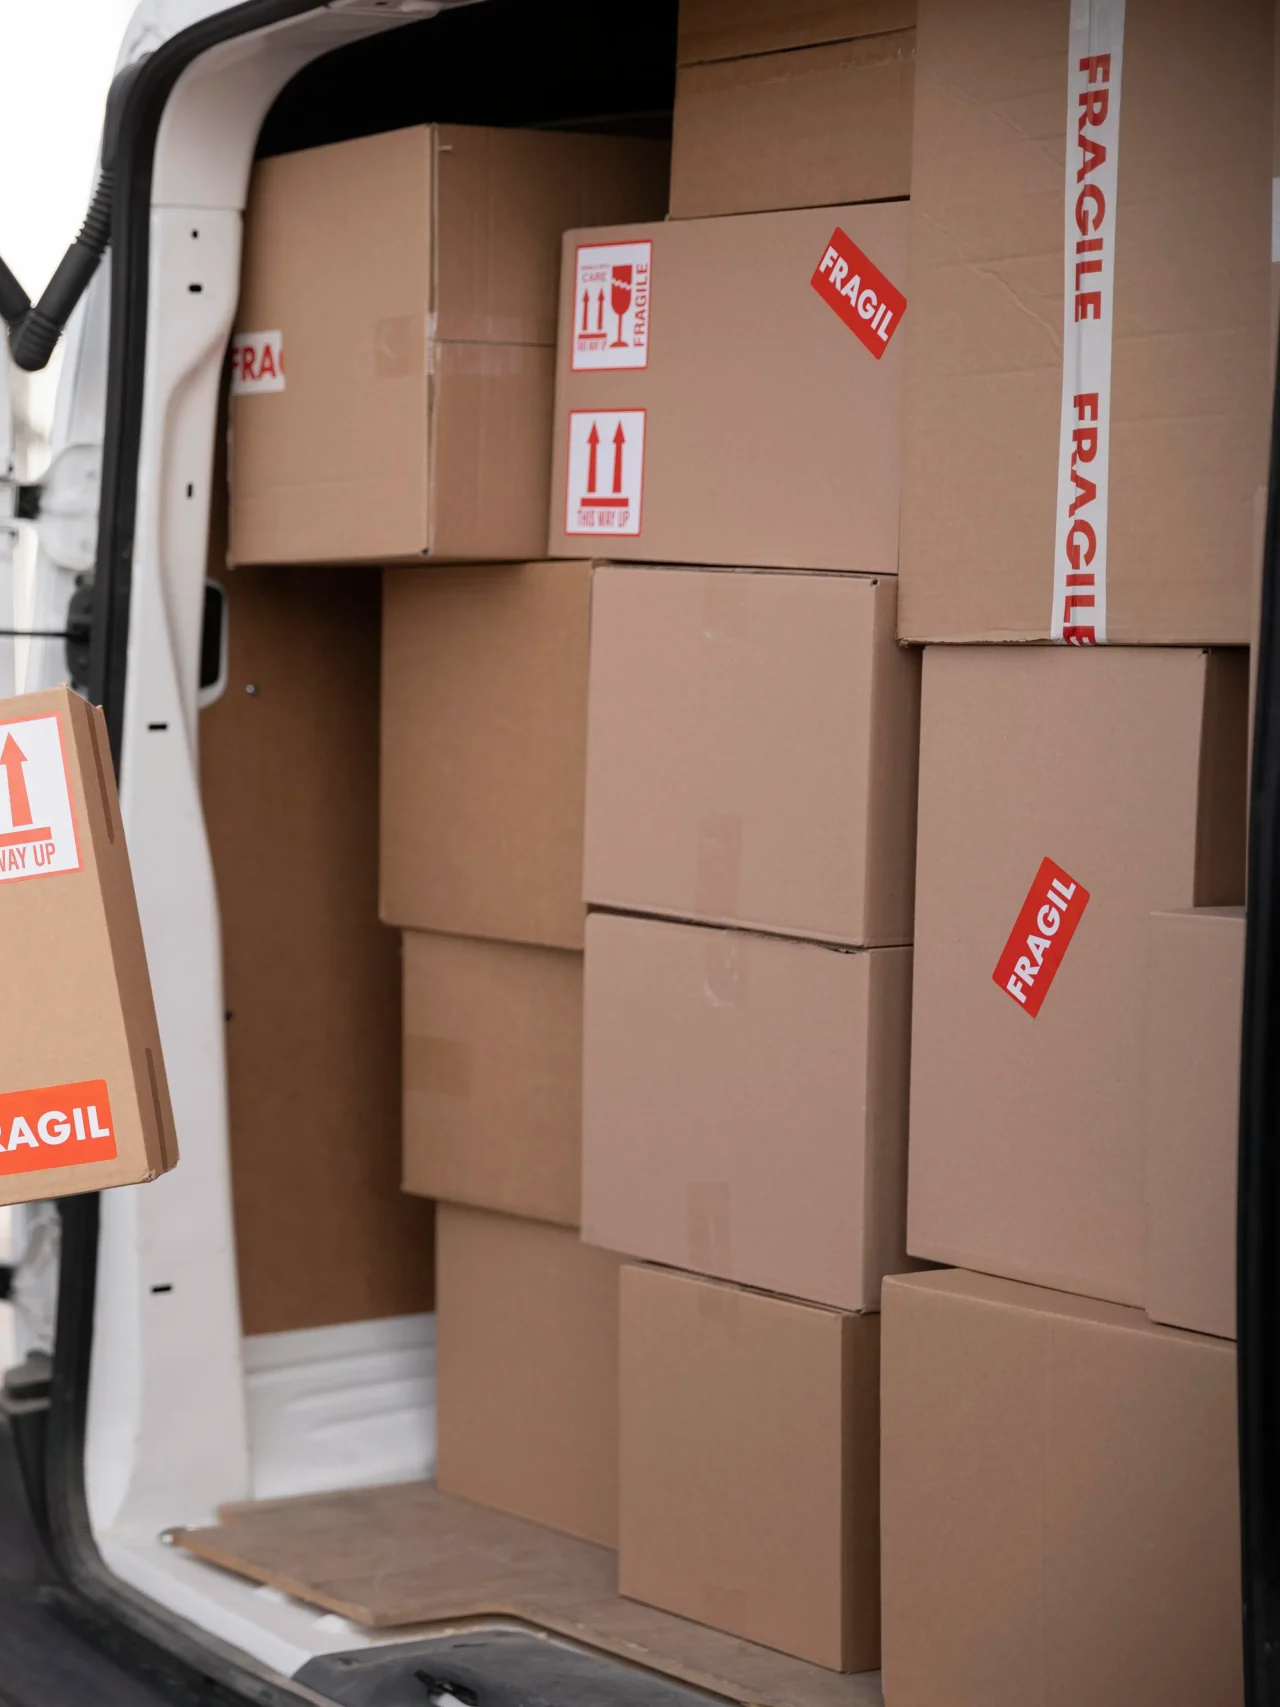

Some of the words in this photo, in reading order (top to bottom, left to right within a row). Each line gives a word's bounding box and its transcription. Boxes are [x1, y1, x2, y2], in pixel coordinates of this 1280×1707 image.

[1074, 53, 1111, 323] FRAGILE
[633, 264, 648, 347] FRAGILE
[819, 245, 893, 342] FRAGIL
[231, 345, 285, 381] FRA
[577, 509, 595, 528] THIS
[598, 509, 616, 527] WAY
[618, 509, 630, 528] UP
[1063, 392, 1099, 646] FRAGILE
[33, 842, 56, 867] UP
[1006, 878, 1077, 1004] FRAGIL
